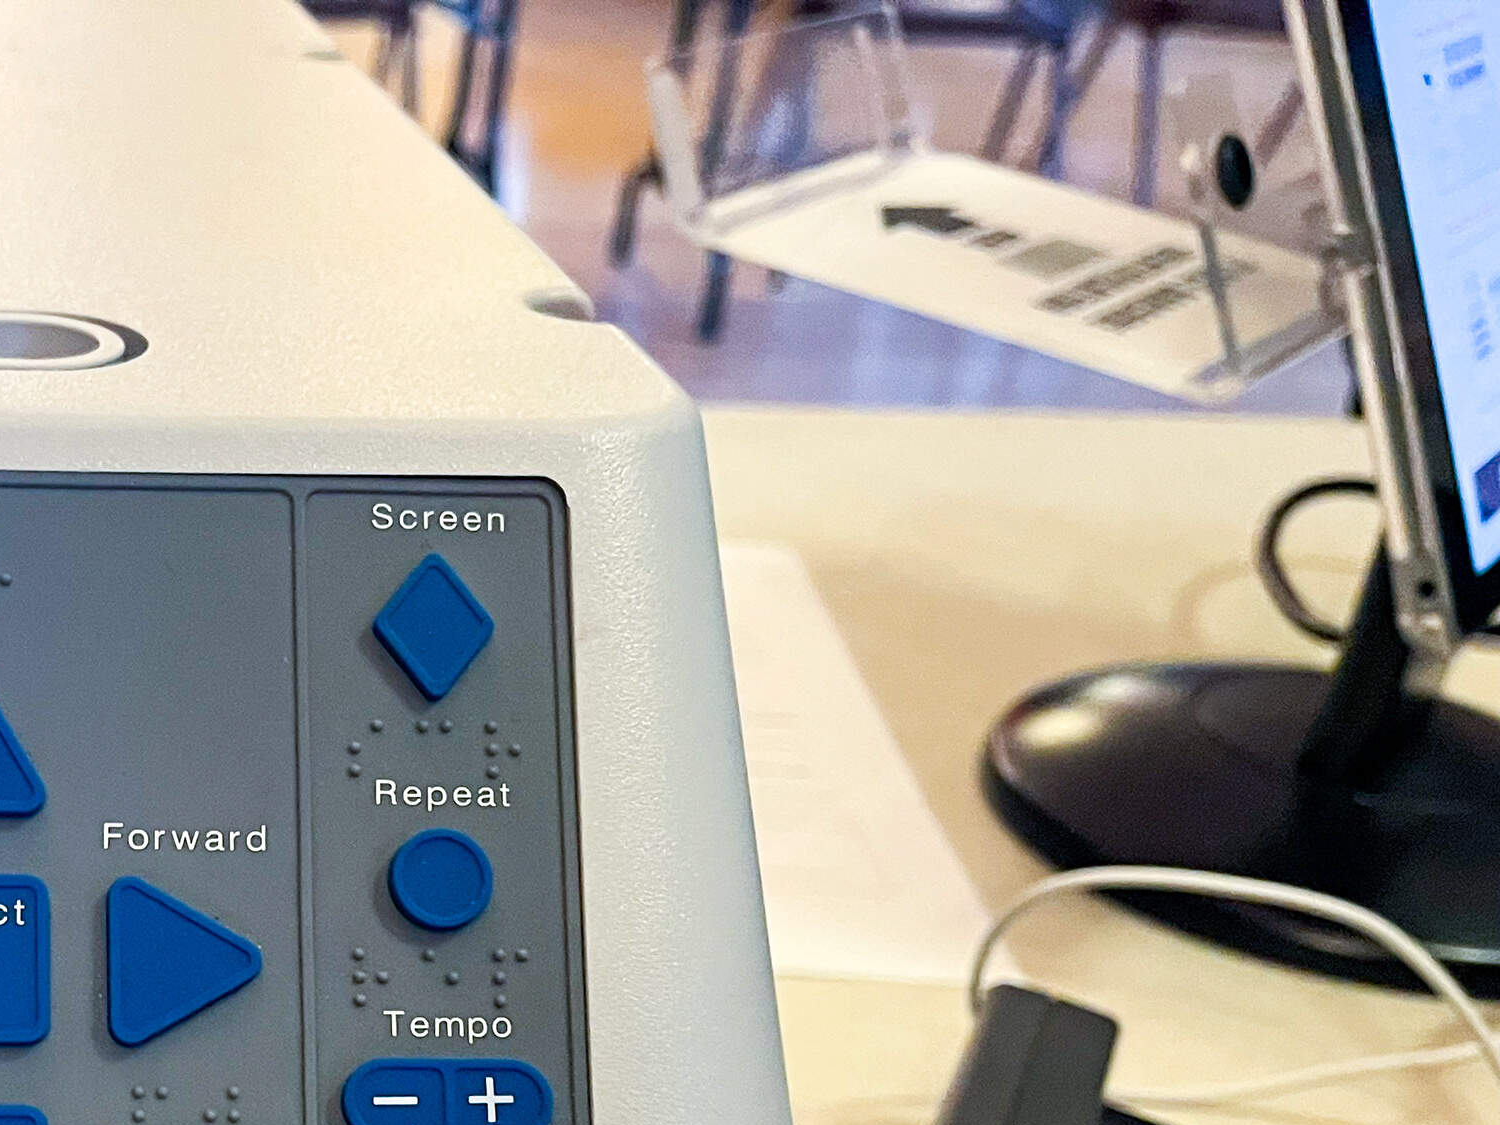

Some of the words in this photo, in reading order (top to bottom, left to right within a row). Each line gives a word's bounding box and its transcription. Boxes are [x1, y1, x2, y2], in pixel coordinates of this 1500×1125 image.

[371, 503, 505, 533] Screen
[375, 779, 511, 812] Repeat
[103, 822, 266, 852] Forward
[382, 1010, 512, 1044] Tempo
